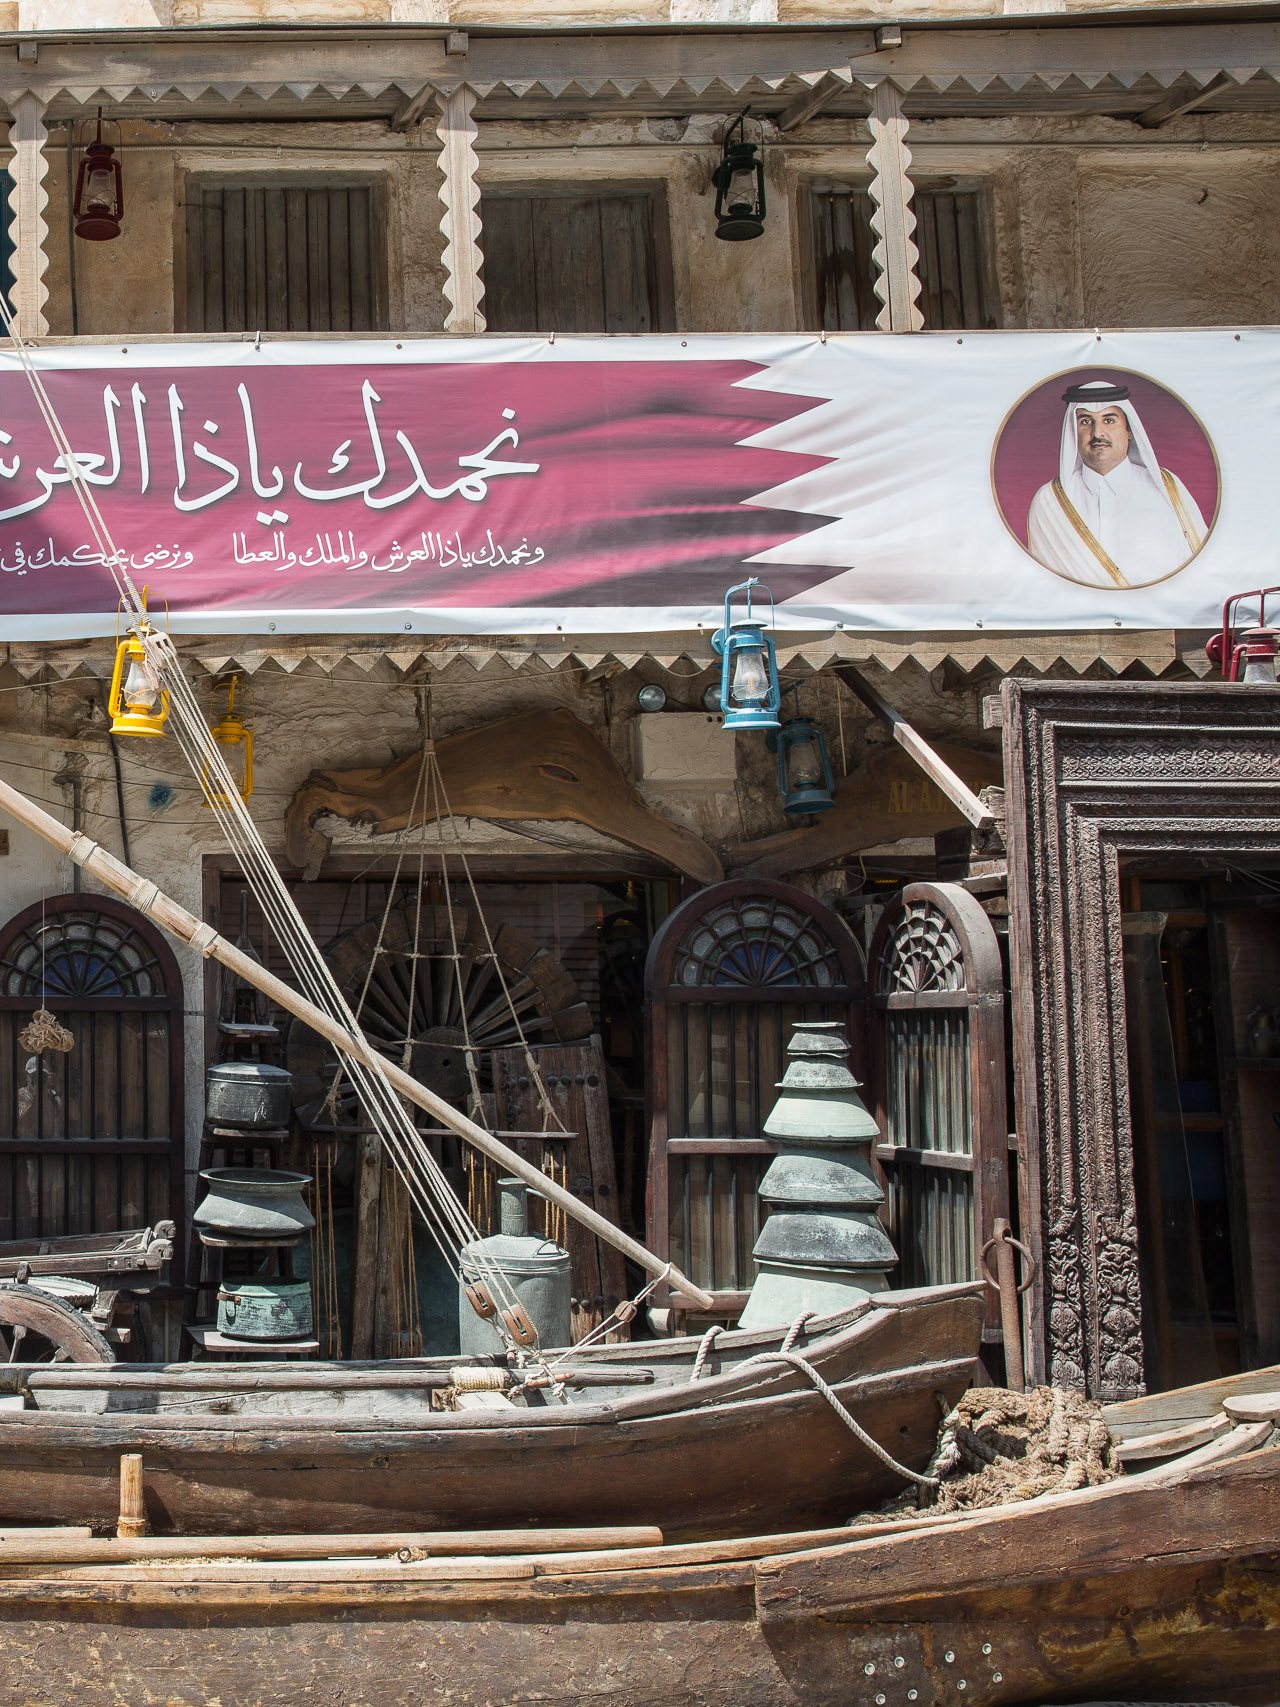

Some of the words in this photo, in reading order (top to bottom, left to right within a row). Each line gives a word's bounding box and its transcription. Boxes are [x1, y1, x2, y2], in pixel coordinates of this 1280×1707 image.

[293, 379, 540, 509] نحمدك
[0, 541, 27, 576] في
[27, 536, 130, 570] بحكمك
[130, 543, 194, 569] ونرضى
[232, 529, 297, 571] والعطا
[298, 529, 369, 571] والملك
[371, 530, 437, 572] العرش
[471, 528, 545, 567] ونحمدك
[888, 781, 913, 813] AL
